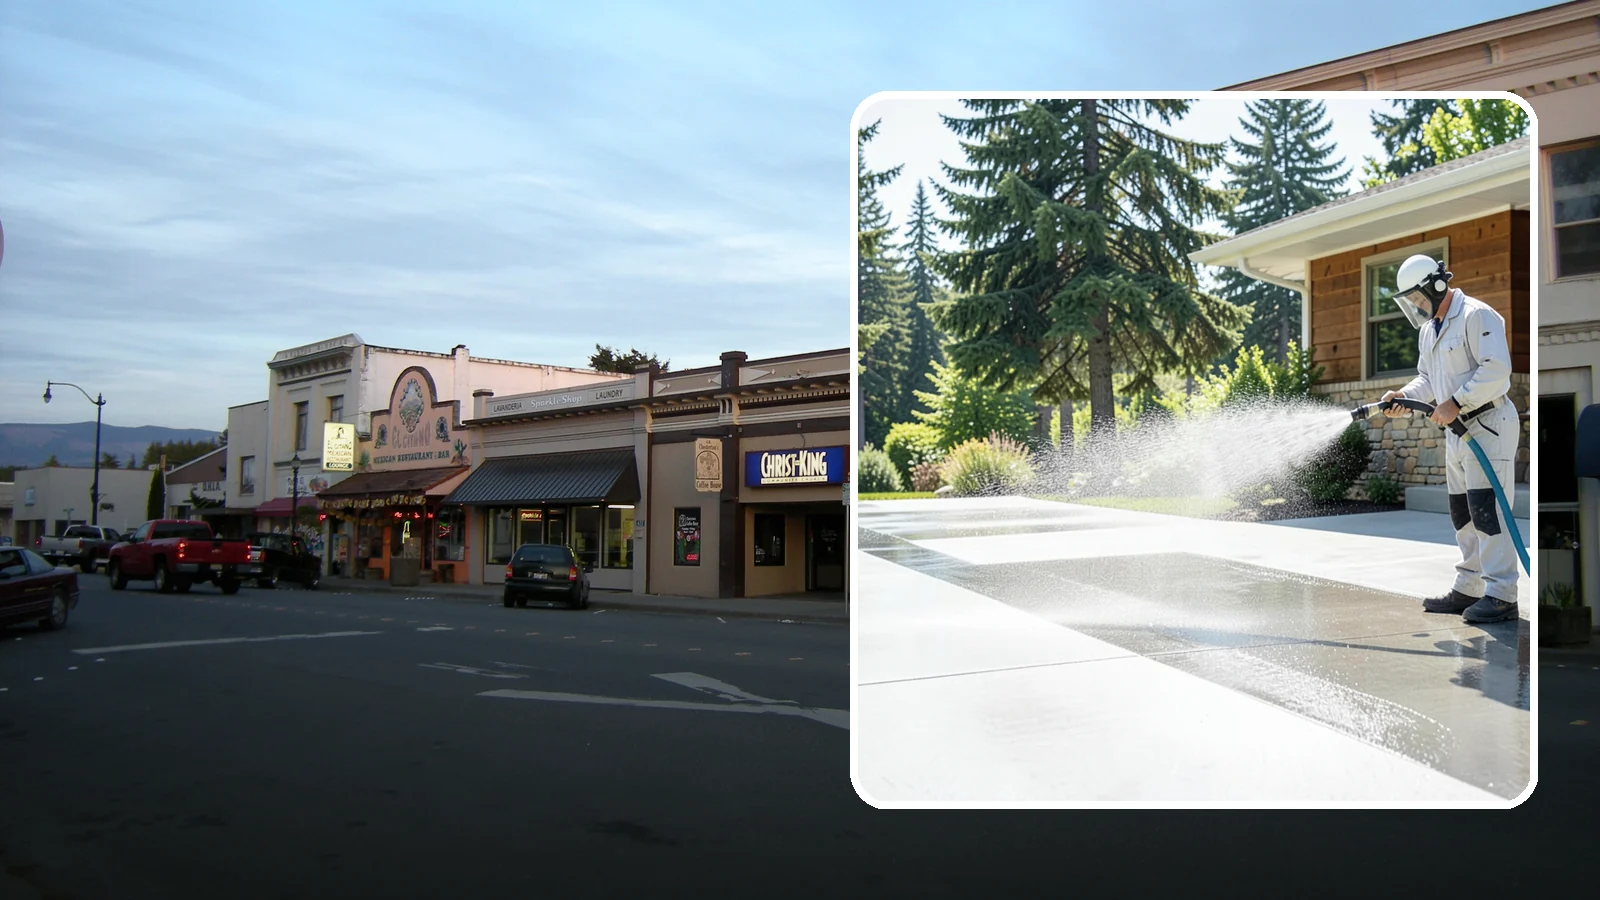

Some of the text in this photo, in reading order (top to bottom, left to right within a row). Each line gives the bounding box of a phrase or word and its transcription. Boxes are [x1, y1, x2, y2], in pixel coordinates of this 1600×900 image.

[531, 394, 582, 409] Sparkle Shop
[595, 389, 623, 400] LAUNDRY
[493, 402, 522, 413] LAVANDERIA
[373, 454, 396, 464] MEXICAN
[397, 451, 433, 462] RESTAURANT
[438, 450, 450, 459] BAR
[761, 450, 827, 478] CHRIST KING
